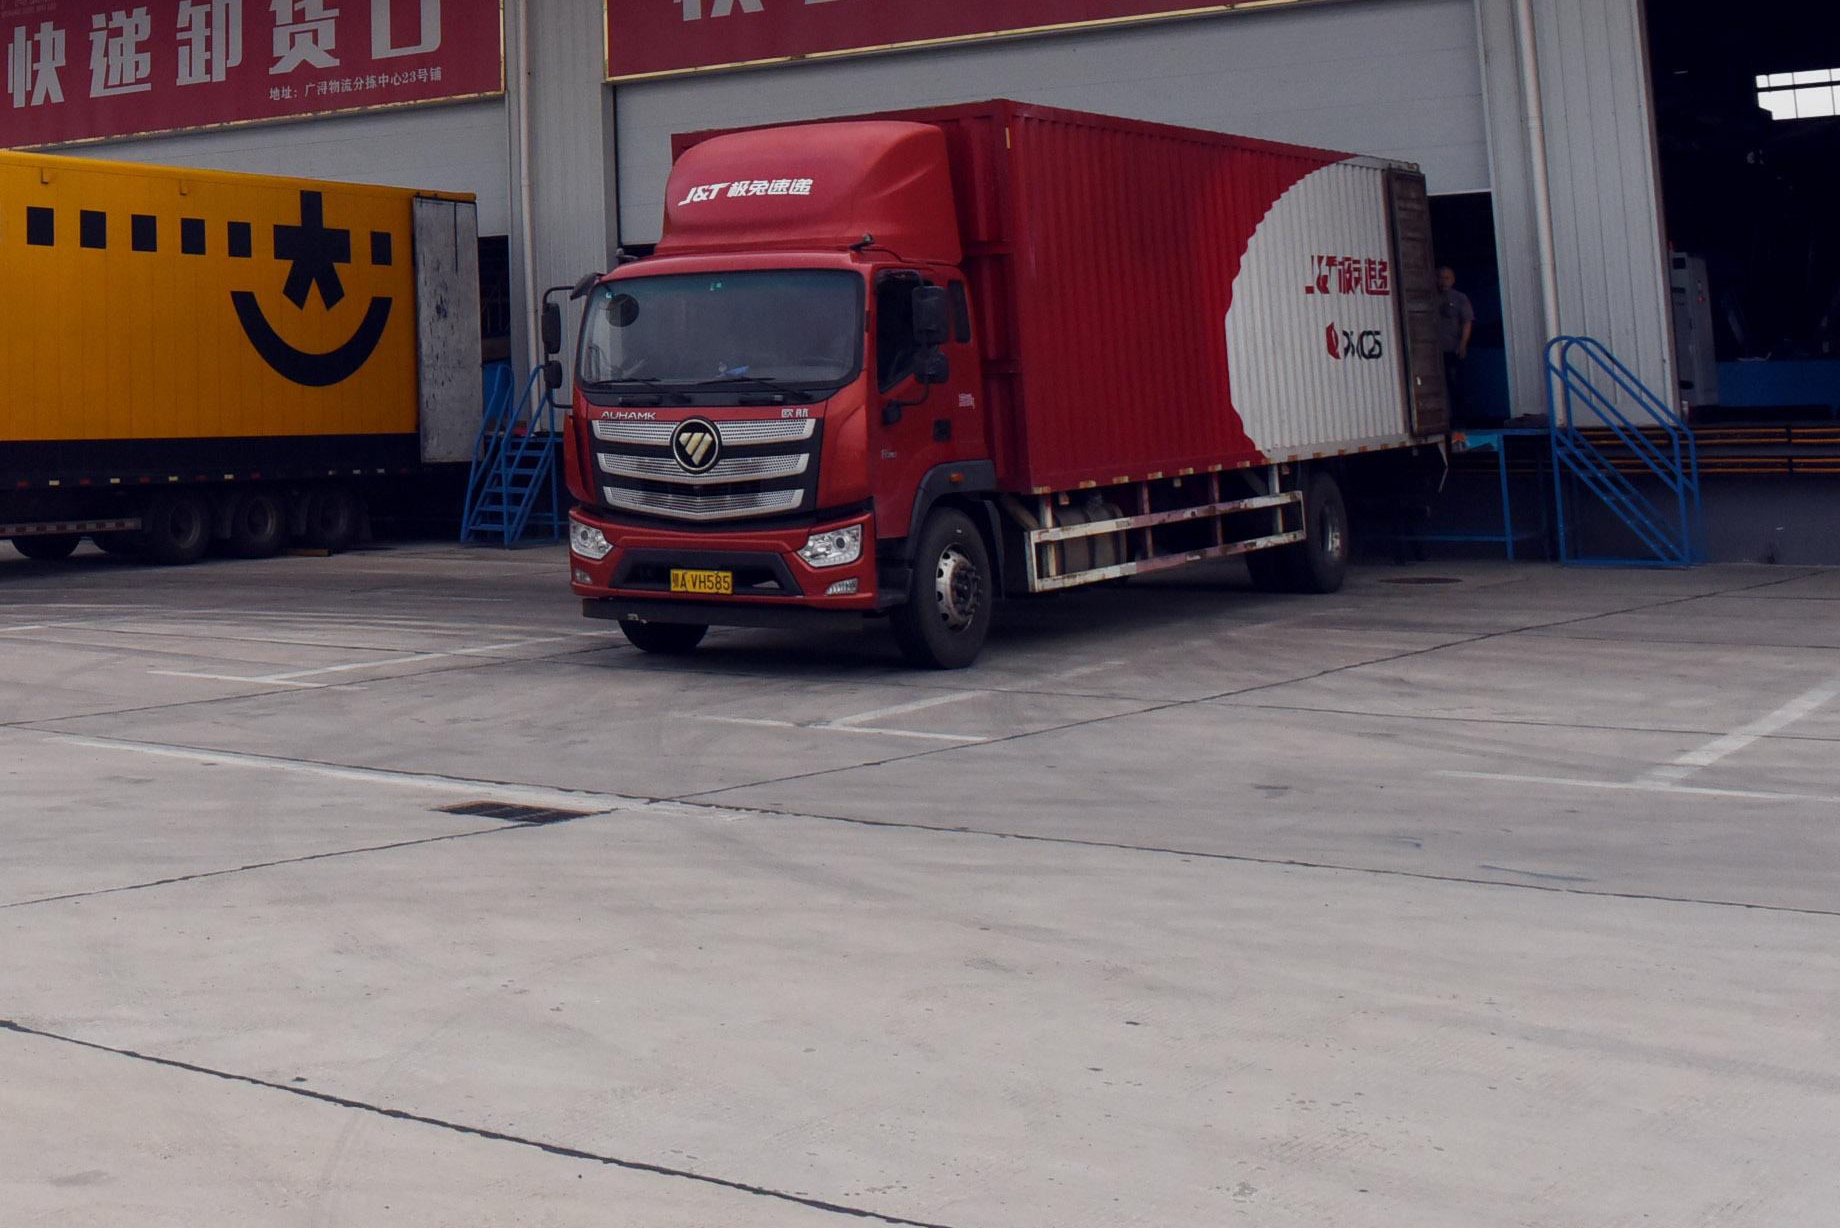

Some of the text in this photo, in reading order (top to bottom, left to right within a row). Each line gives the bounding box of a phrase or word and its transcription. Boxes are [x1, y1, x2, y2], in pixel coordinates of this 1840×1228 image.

[677, 178, 814, 206] J&T 极兔速递
